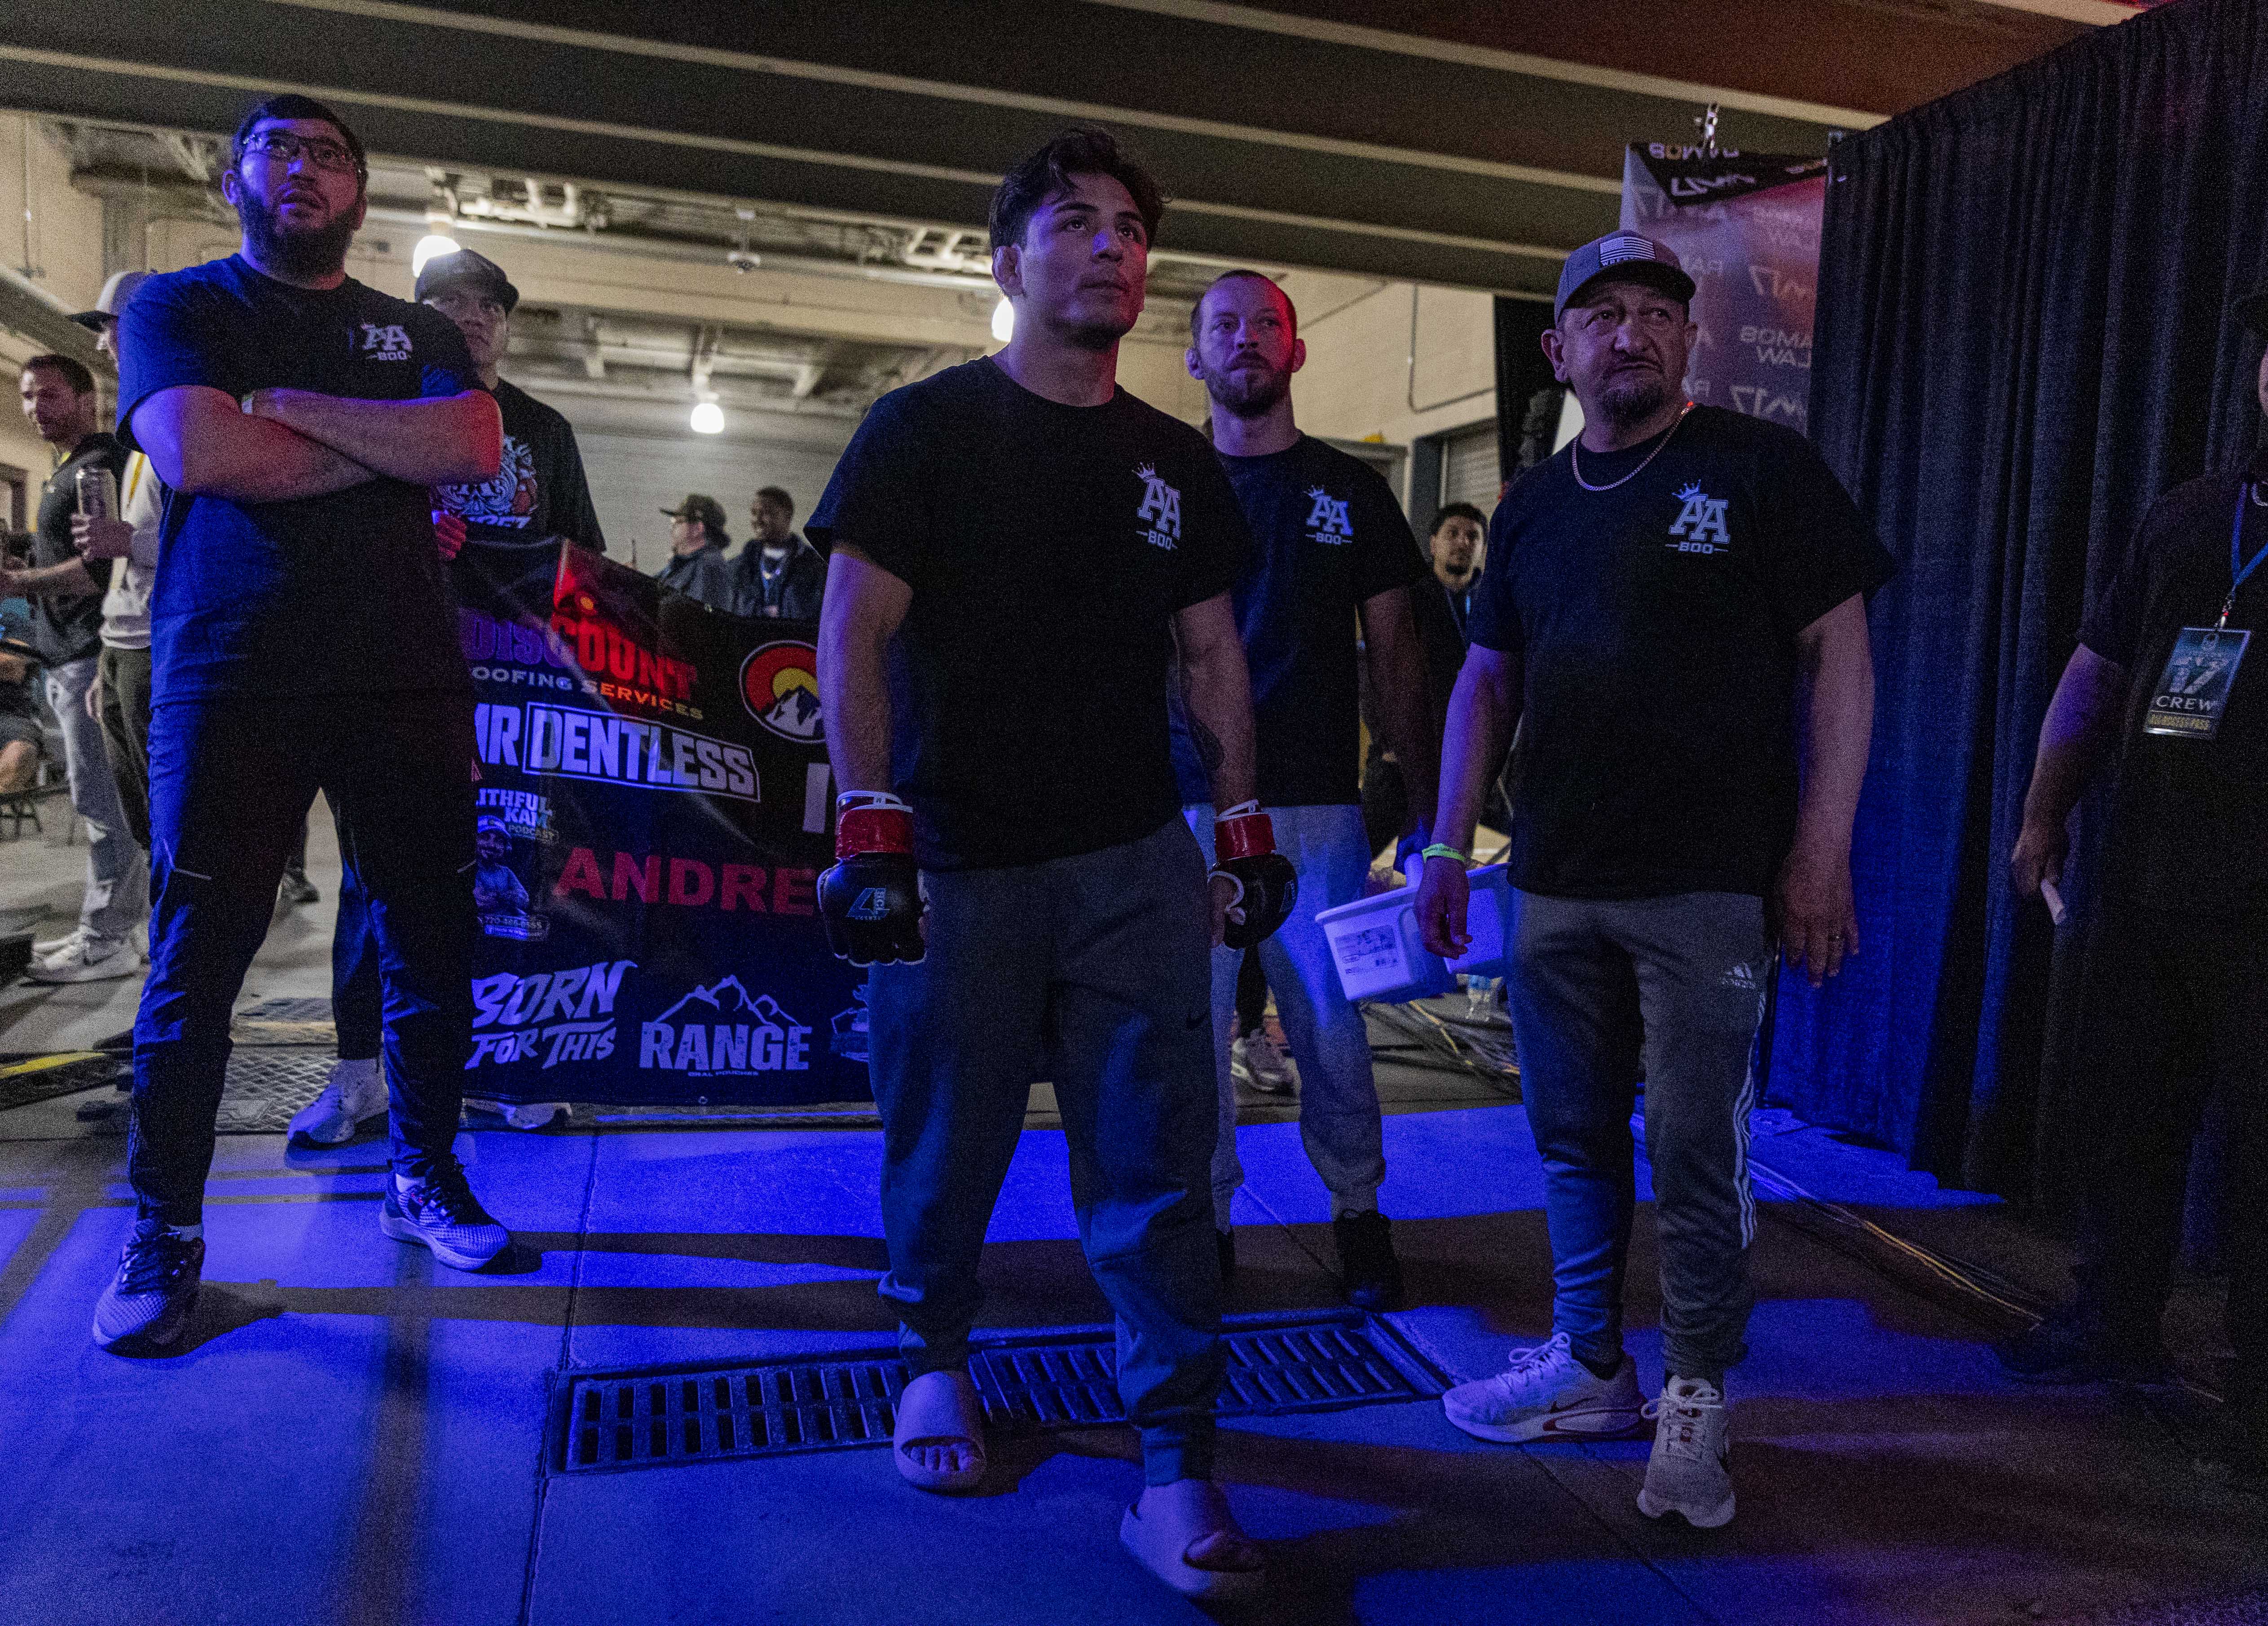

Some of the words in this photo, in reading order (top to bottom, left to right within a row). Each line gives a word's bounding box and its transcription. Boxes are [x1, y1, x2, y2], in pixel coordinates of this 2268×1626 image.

[1136, 477, 1181, 540] AA
[1305, 495, 1354, 537] AA
[1668, 494, 1731, 544] AA
[461, 610, 697, 700] DISCOUNT
[580, 679, 704, 721] SERVICES
[2156, 695, 2218, 711] CREW
[529, 708, 755, 796] DENTLESS
[475, 787, 553, 817] ITHFUL
[471, 959, 639, 1029] BORN
[464, 1027, 539, 1071] FOR
[542, 1017, 617, 1070] THIS
[639, 1021, 813, 1071] RANGE
